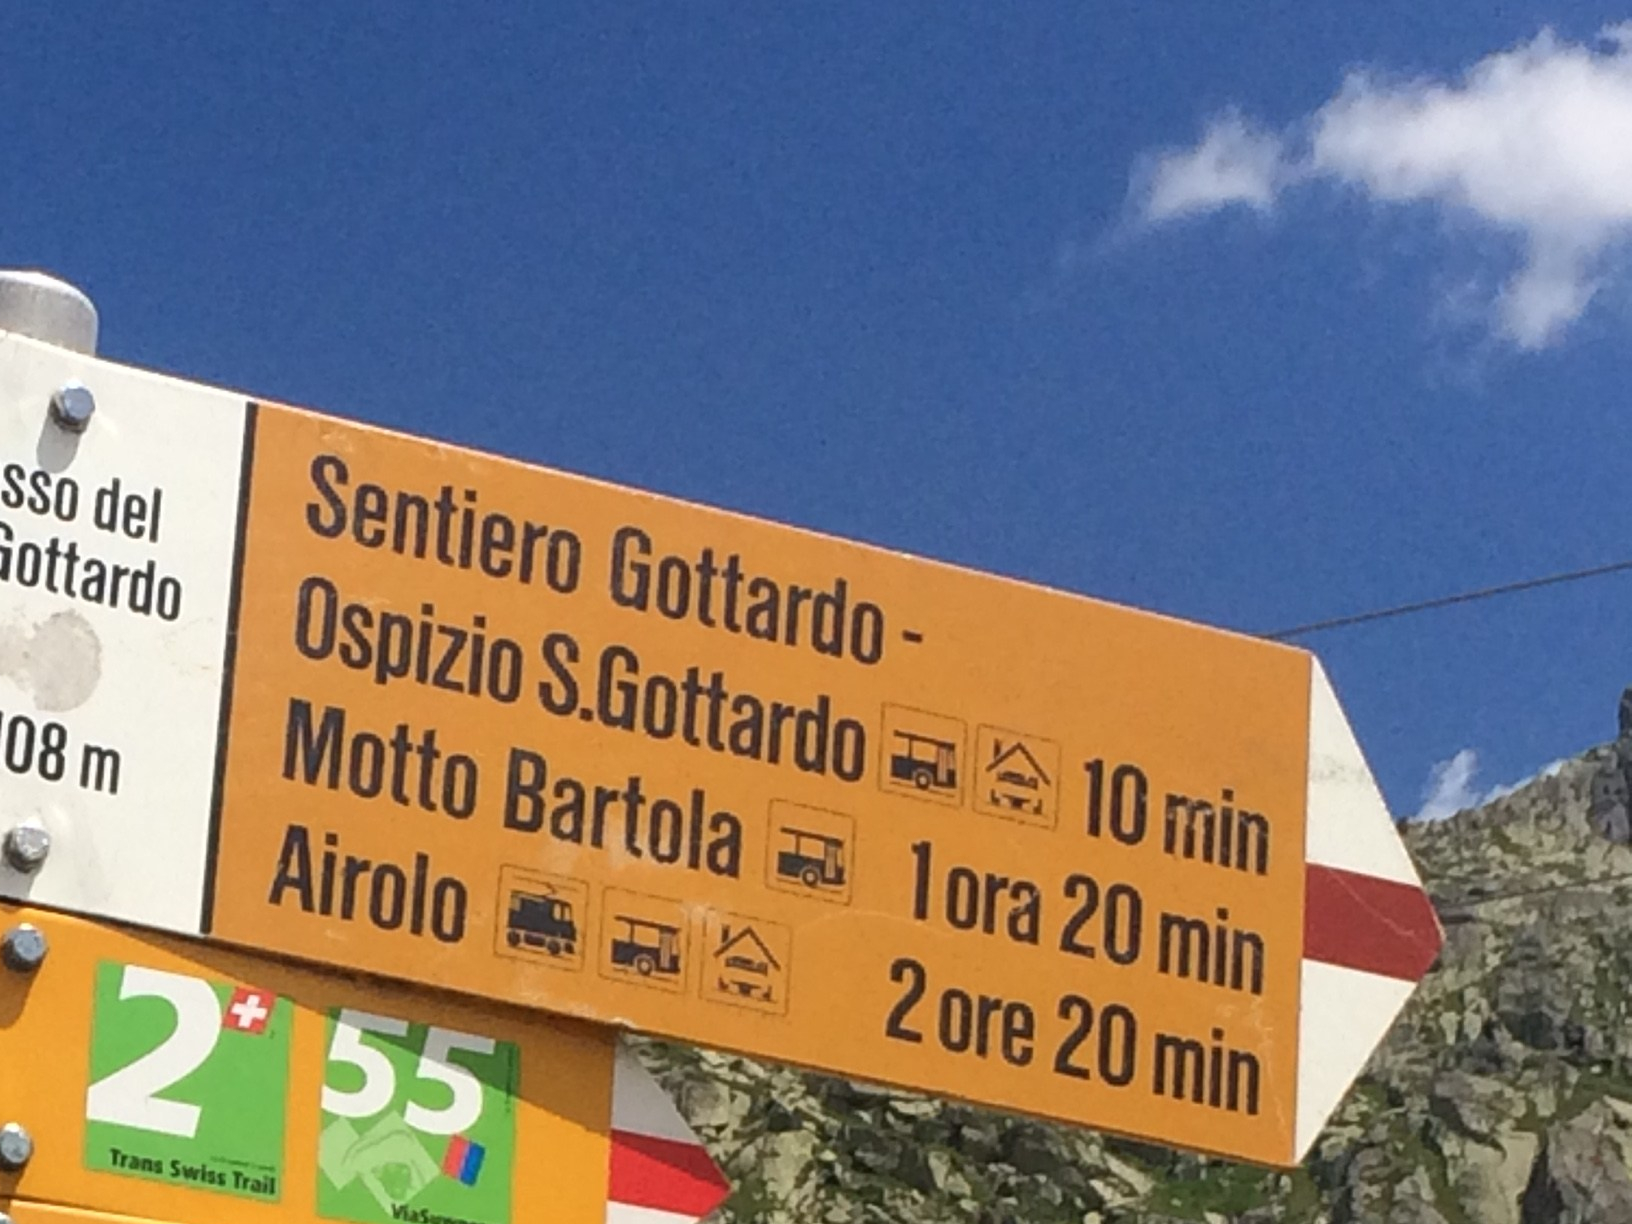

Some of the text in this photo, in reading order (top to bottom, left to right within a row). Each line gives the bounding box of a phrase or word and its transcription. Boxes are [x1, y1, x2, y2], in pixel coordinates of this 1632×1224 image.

[93, 477, 162, 543] del
[306, 454, 582, 594] Sentiero
[610, 526, 884, 666] Gottardo
[295, 576, 523, 704] Ospizio
[79, 744, 121, 795] m
[282, 697, 742, 879] Motto Bartola
[1084, 758, 1269, 876] 10 min
[268, 824, 468, 943] Airolo
[1059, 874, 1143, 966] 20
[1158, 907, 1265, 996] min
[86, 964, 222, 1138] 2
[321, 1008, 495, 1136] 55
[1053, 994, 1137, 1087] 20
[1152, 1027, 1260, 1116] min
[110, 1149, 164, 1176] Trans
[170, 1159, 227, 1189] Swiss
[231, 1171, 277, 1197] Trail
